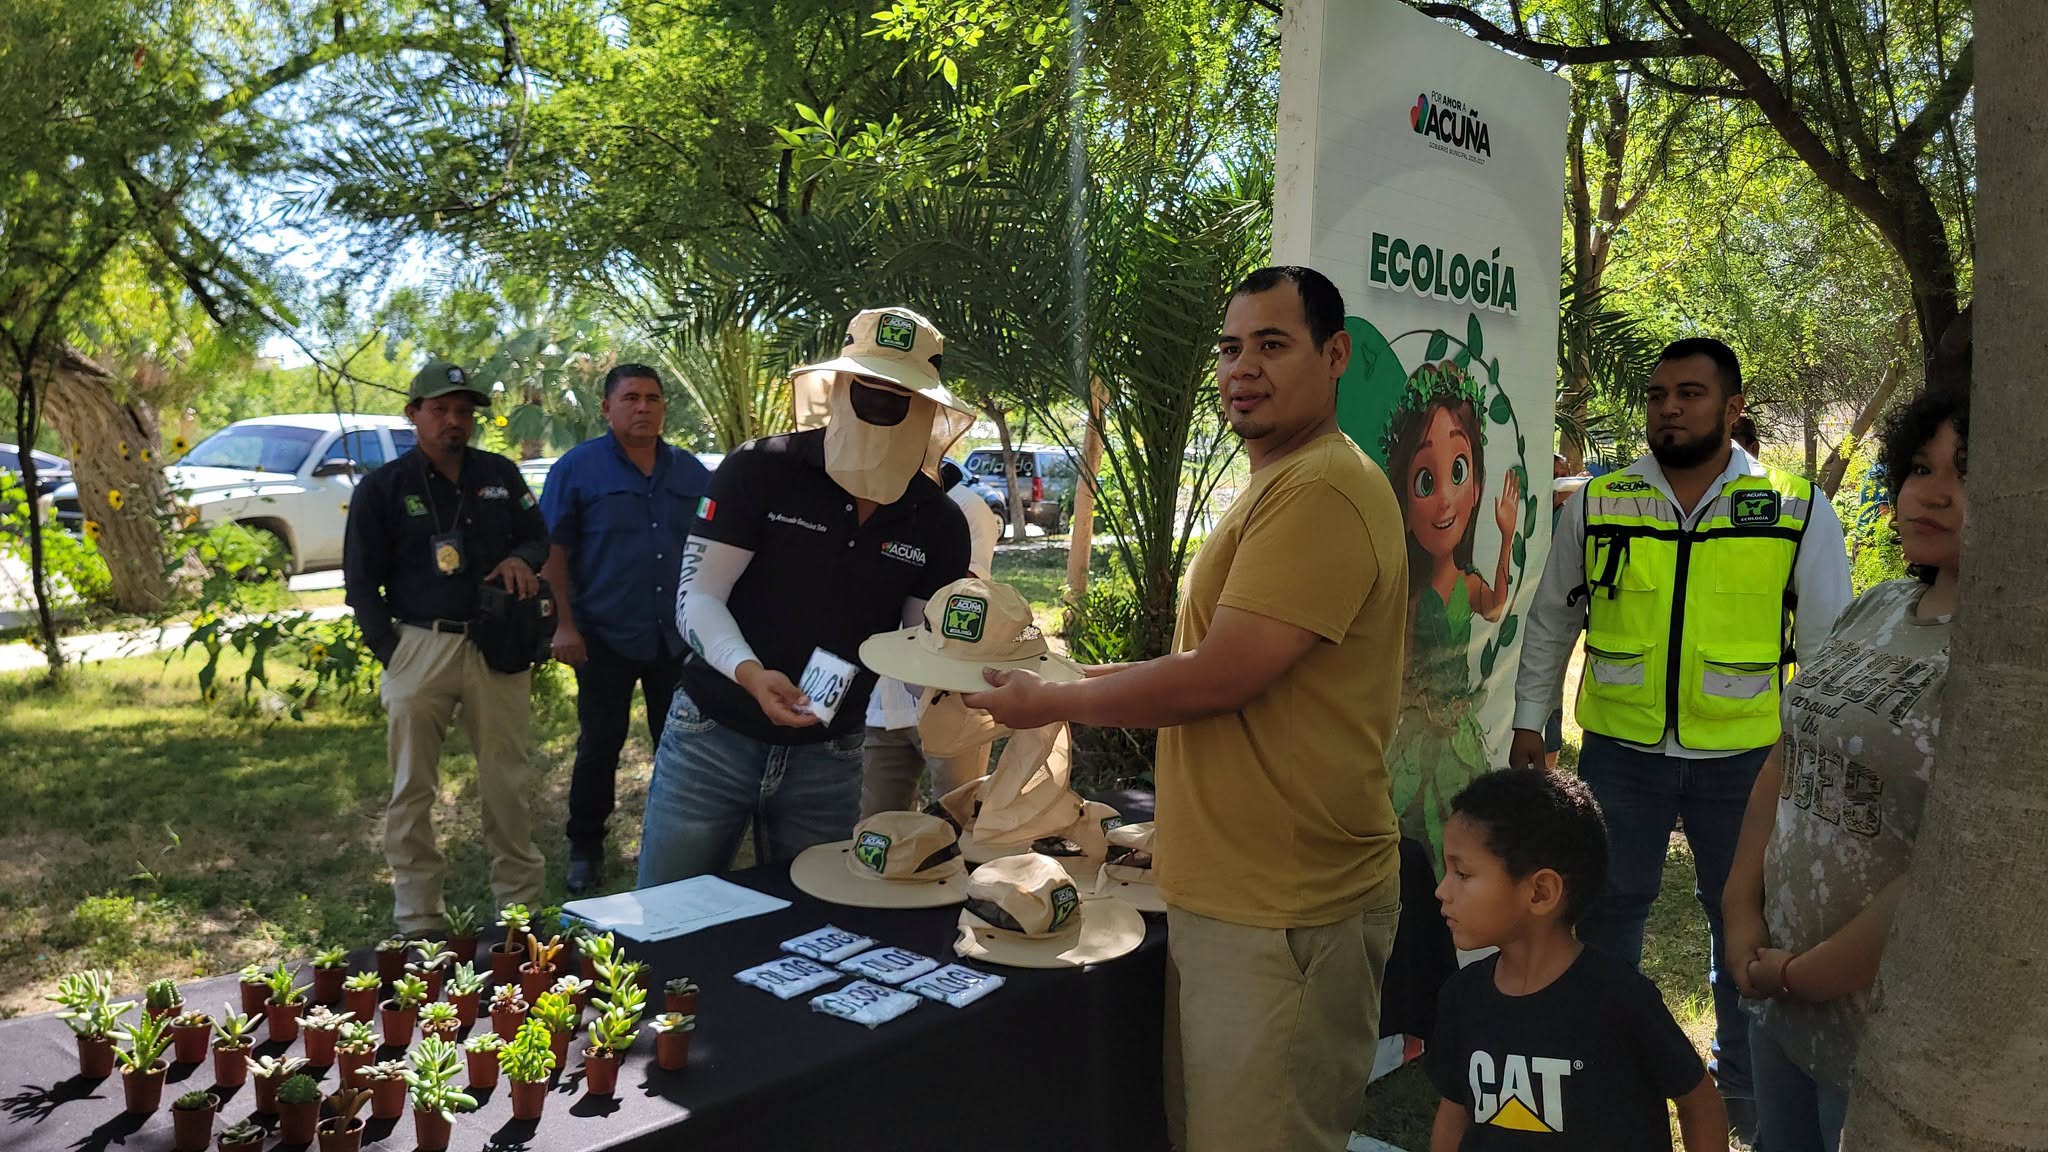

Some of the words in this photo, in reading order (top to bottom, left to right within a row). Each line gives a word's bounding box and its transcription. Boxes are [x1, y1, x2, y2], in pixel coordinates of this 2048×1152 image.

[1431, 90, 1442, 103] POR
[1442, 95, 1462, 111] AMOR
[1424, 103, 1491, 158] ACUÑA
[1369, 231, 1518, 312] ECOLOGÍA
[967, 457, 1033, 474] Orlado
[889, 543, 926, 564] ACUÑA
[1791, 695, 1848, 719] around
[1801, 715, 1819, 737] the
[1468, 1050, 1571, 1133] CAT
